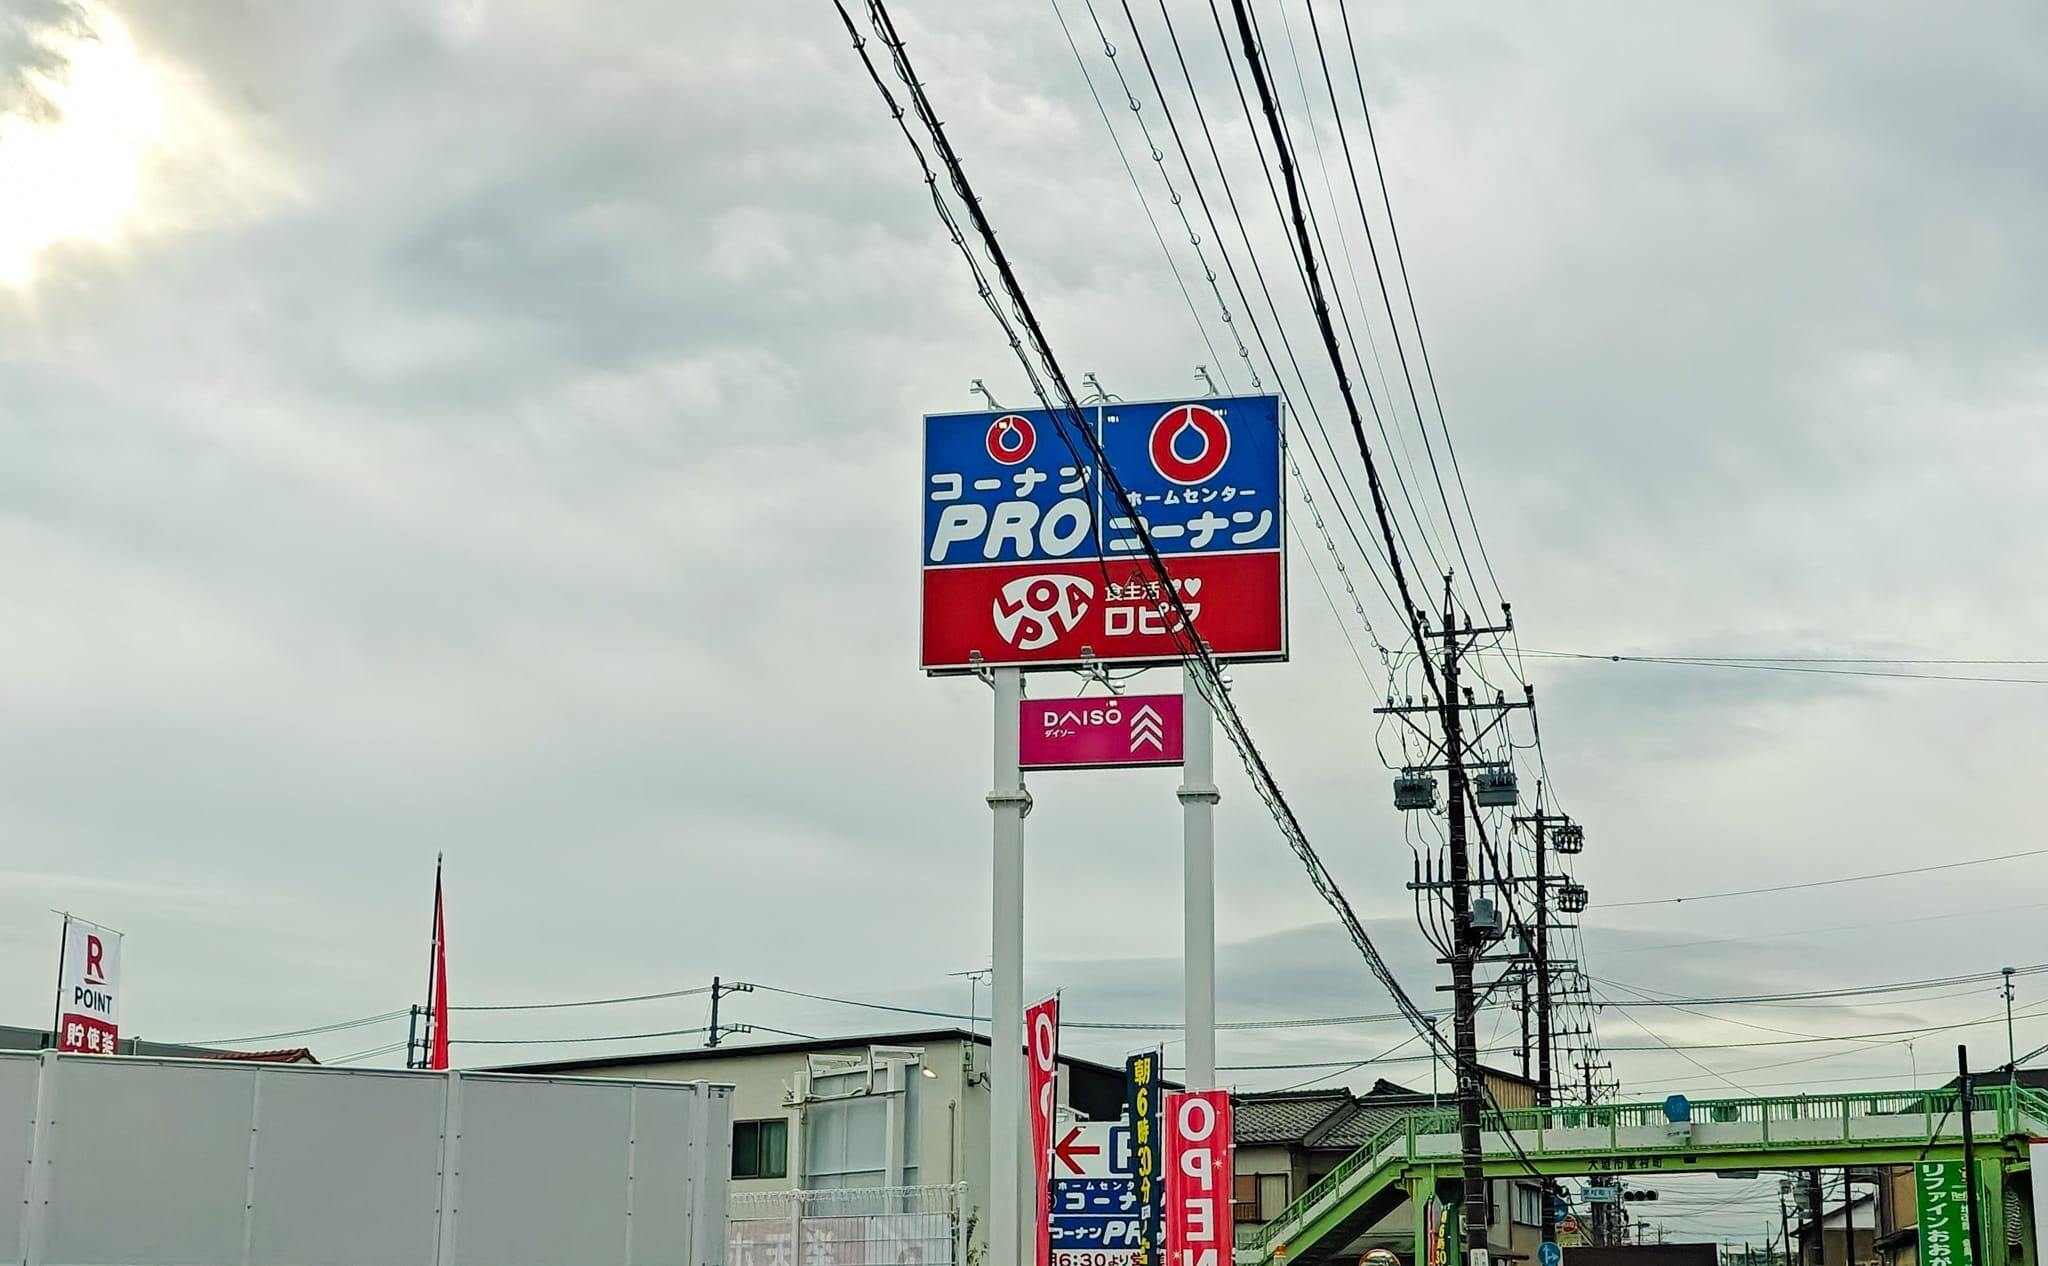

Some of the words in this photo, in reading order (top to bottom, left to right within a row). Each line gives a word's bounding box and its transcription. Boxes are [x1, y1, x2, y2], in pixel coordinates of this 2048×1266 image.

[931, 466, 1092, 501] コーナン
[1126, 485, 1256, 507] ホームセンター
[930, 498, 1091, 562] PRO
[1109, 509, 1273, 551] コーナン
[1105, 581, 1160, 601] 食生活
[995, 577, 1094, 650] LOPIA
[1044, 709, 1122, 727] DAISO
[1044, 728, 1076, 738] ダイソー
[75, 986, 112, 1015] POINT
[1058, 1181, 1135, 1191] ホームセンタ
